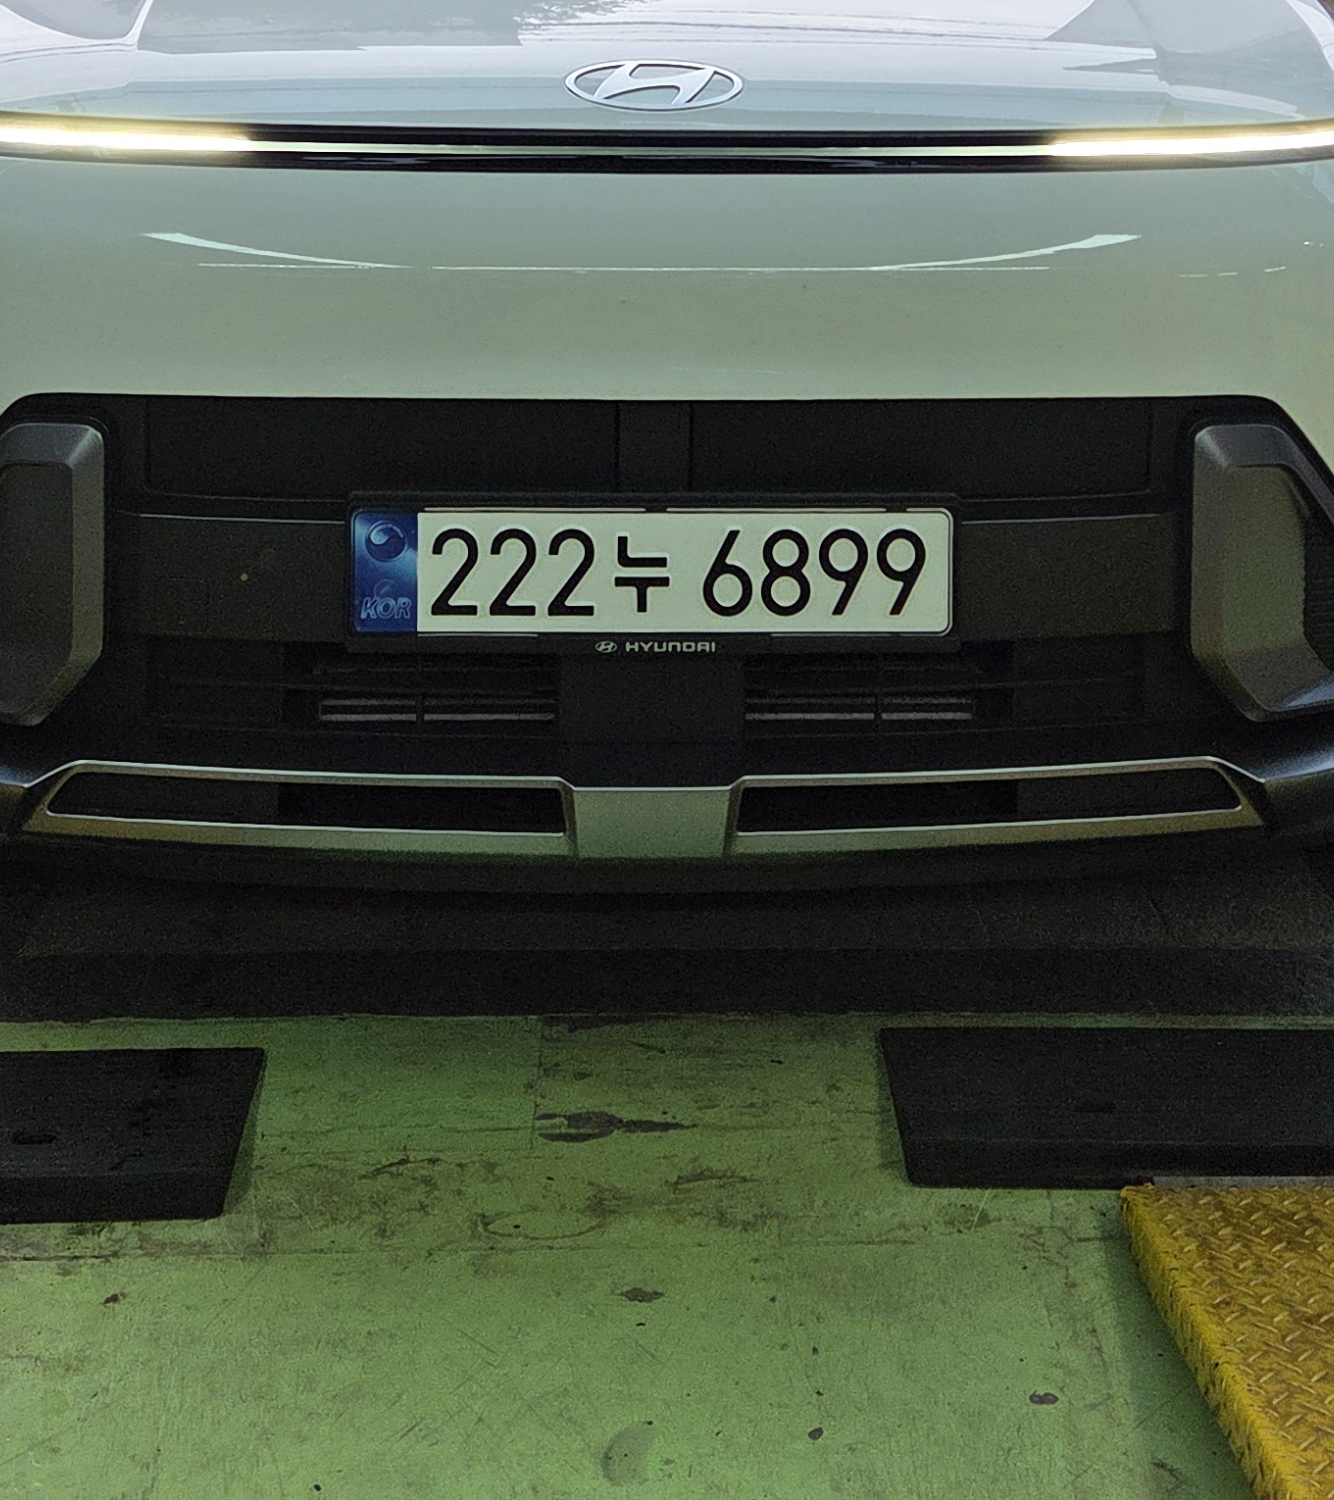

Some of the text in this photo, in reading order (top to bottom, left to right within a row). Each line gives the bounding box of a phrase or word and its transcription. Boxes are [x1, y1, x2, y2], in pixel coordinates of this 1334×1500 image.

[430, 528, 928, 617] 222누 6899
[360, 596, 413, 620] KOR
[625, 641, 716, 653] HYUNDAI
